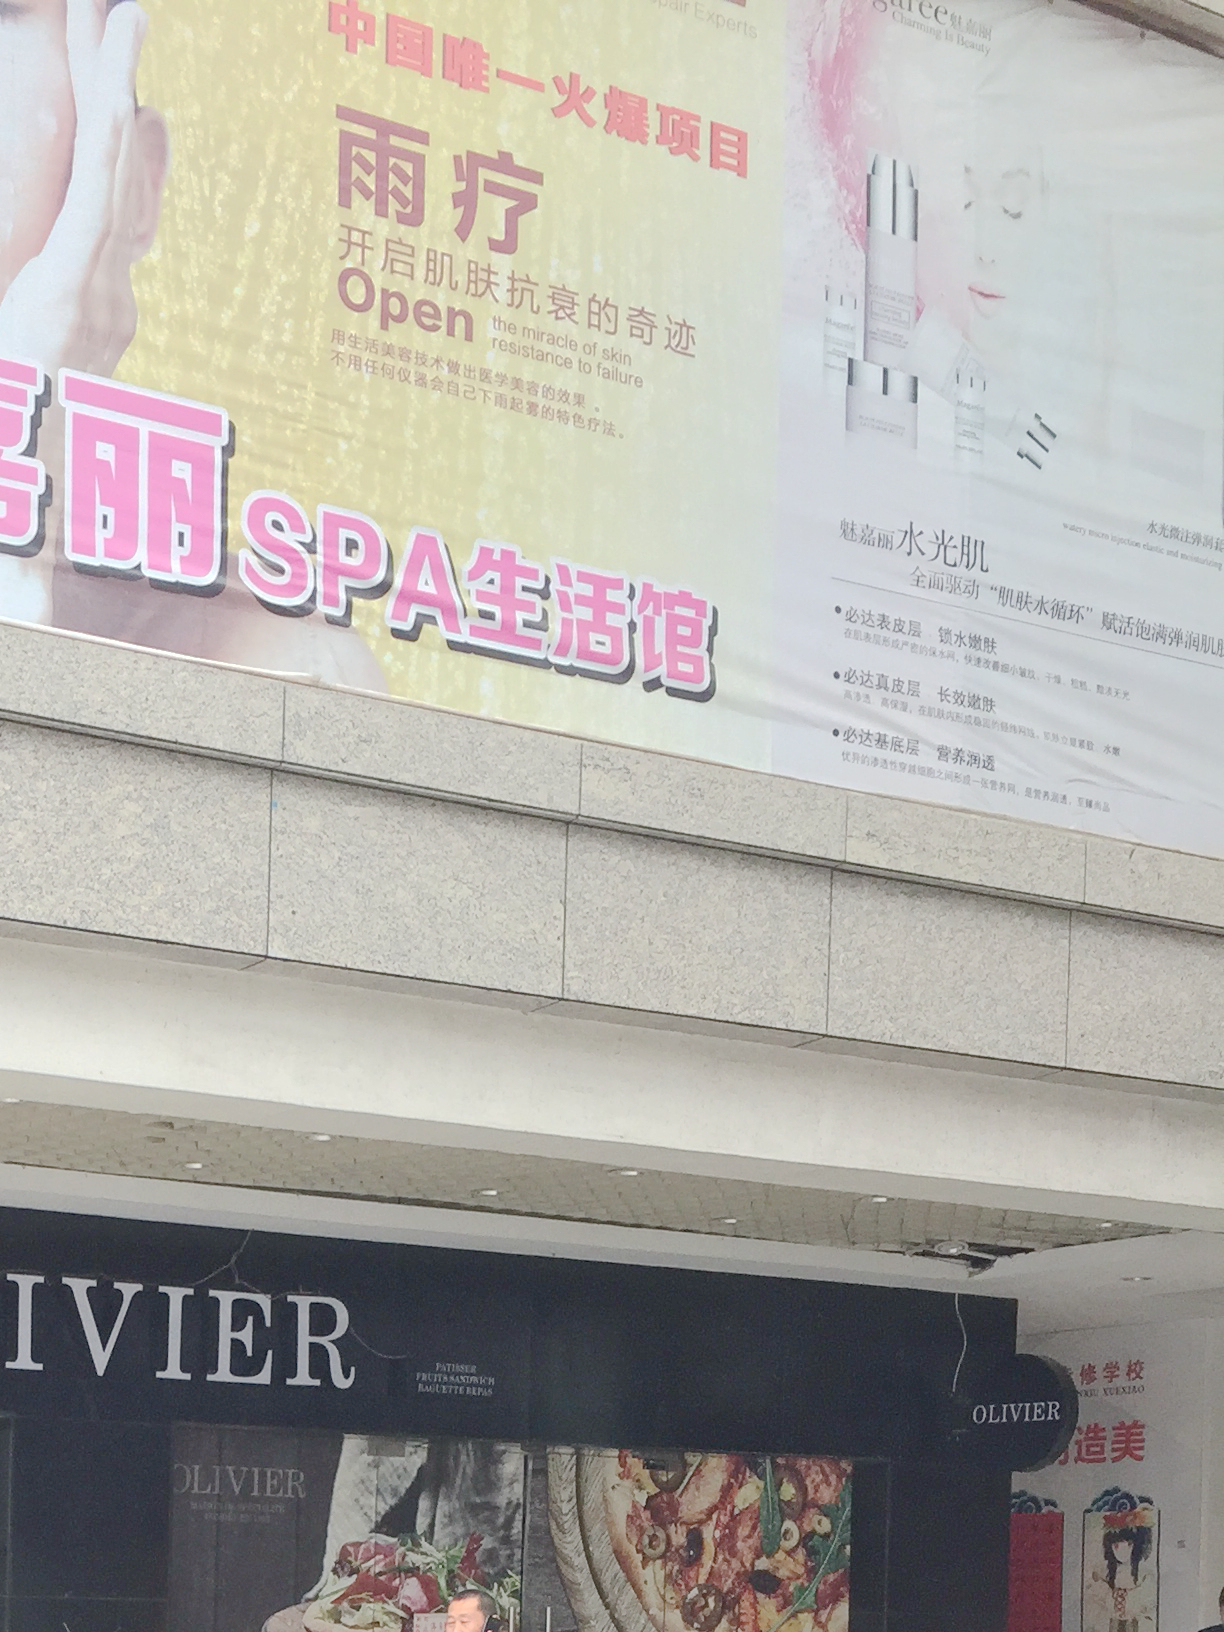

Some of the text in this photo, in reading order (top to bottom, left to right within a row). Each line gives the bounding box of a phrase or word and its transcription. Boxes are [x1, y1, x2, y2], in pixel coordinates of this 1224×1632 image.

[892, 10, 943, 40] Charming
[956, 34, 991, 56] Beauty
[335, 103, 544, 255] 雨疗
[337, 267, 474, 343] Open
[338, 223, 697, 358] 开启肌肤抗衰的奇迹
[492, 315, 633, 367] the miracle of skin
[492, 336, 644, 389] resistance to failure
[844, 606, 998, 656] 必达表皮层 锁水嫩肤
[843, 667, 997, 715] 必达真皮层 长效嫩肤
[842, 727, 996, 773] 必达基底层 营养润透
[972, 1401, 1061, 1425] OLIVIER
[1058, 1419, 1146, 1465] 造美
